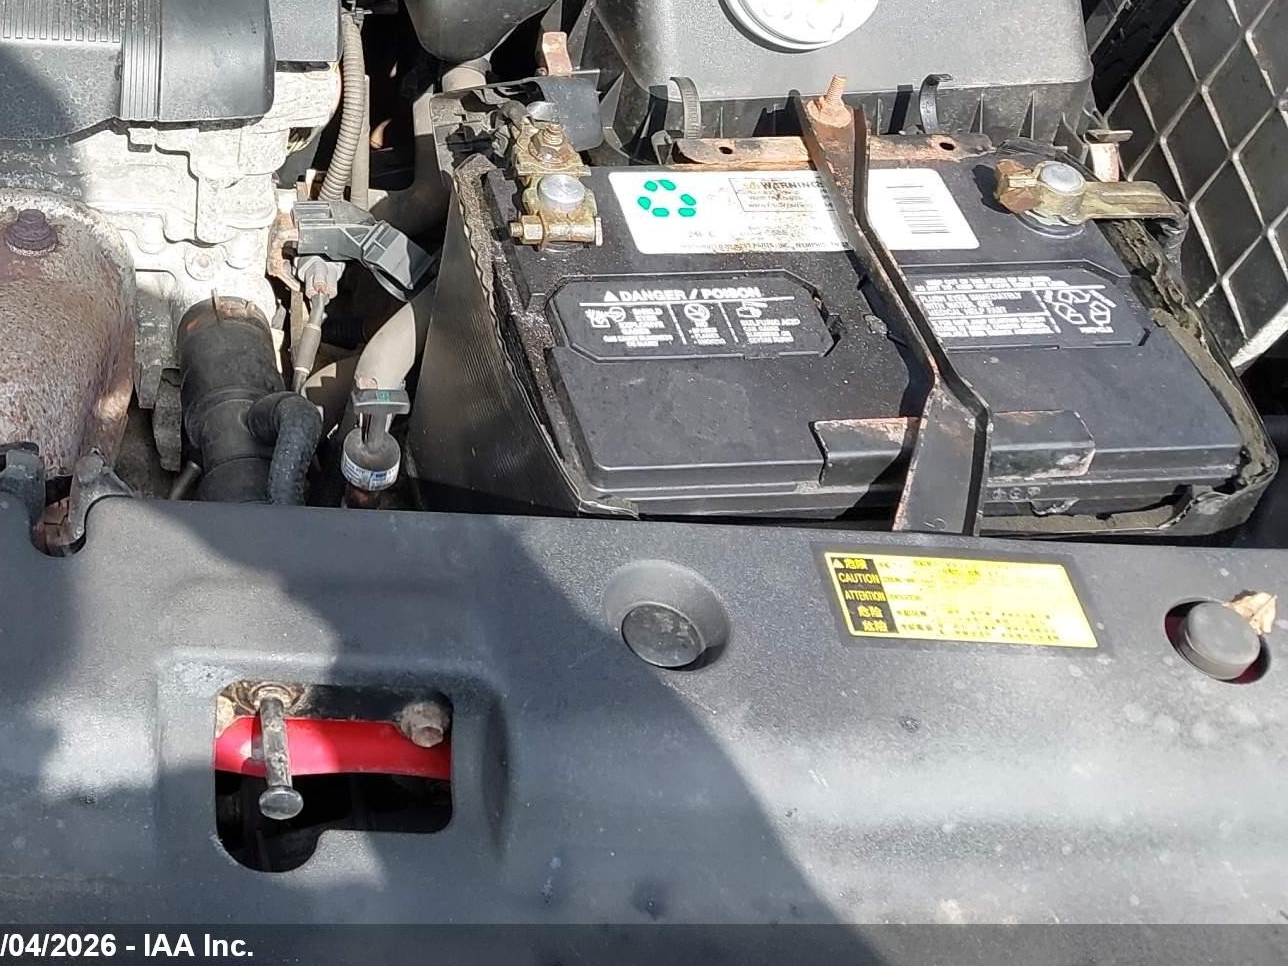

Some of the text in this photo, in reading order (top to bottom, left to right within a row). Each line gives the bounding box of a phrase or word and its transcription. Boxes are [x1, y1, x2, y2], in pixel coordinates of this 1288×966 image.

[618, 286, 762, 301] DANGER / POISON
[838, 572, 881, 584] CAUTION
[844, 589, 887, 602] ATTENTION
